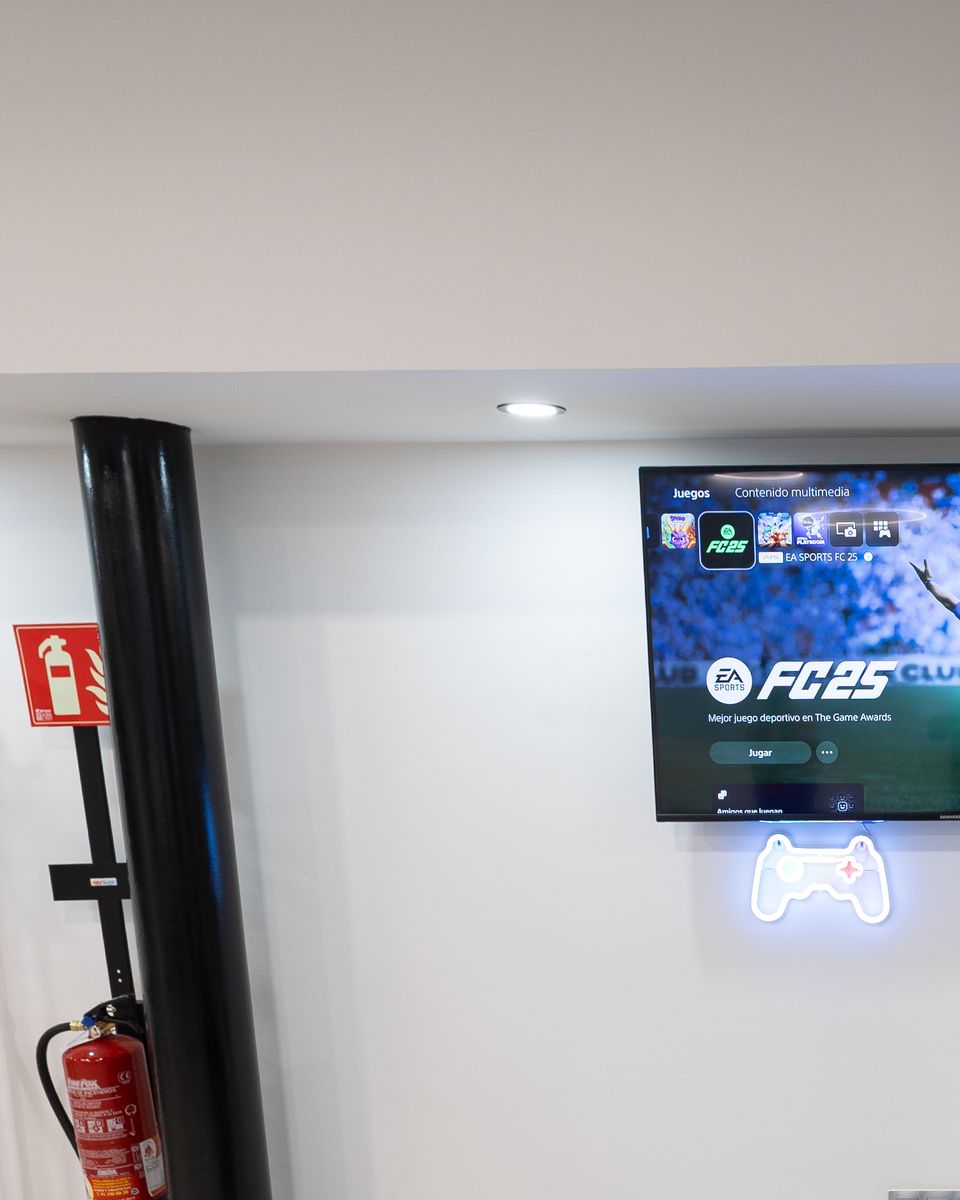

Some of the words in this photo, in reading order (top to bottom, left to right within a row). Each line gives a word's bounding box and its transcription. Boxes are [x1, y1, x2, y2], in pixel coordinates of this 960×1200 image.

[673, 488, 710, 500] Juegos
[735, 486, 789, 498] Contenido
[791, 486, 850, 498] multimedia
[706, 540, 749, 553] FC25
[785, 552, 798, 562] EA
[799, 552, 833, 562] SPORTS
[834, 552, 846, 562] FC
[847, 552, 858, 562] 25
[715, 668, 744, 684] EA
[756, 660, 899, 700] FC25
[714, 683, 745, 692] SPORTS
[708, 713, 733, 724] Mejor
[734, 713, 759, 724] juego
[760, 713, 801, 724] deportivo
[815, 713, 831, 722] The
[832, 713, 858, 722] Game
[860, 712, 892, 722] Awards
[748, 748, 773, 759] Jugar
